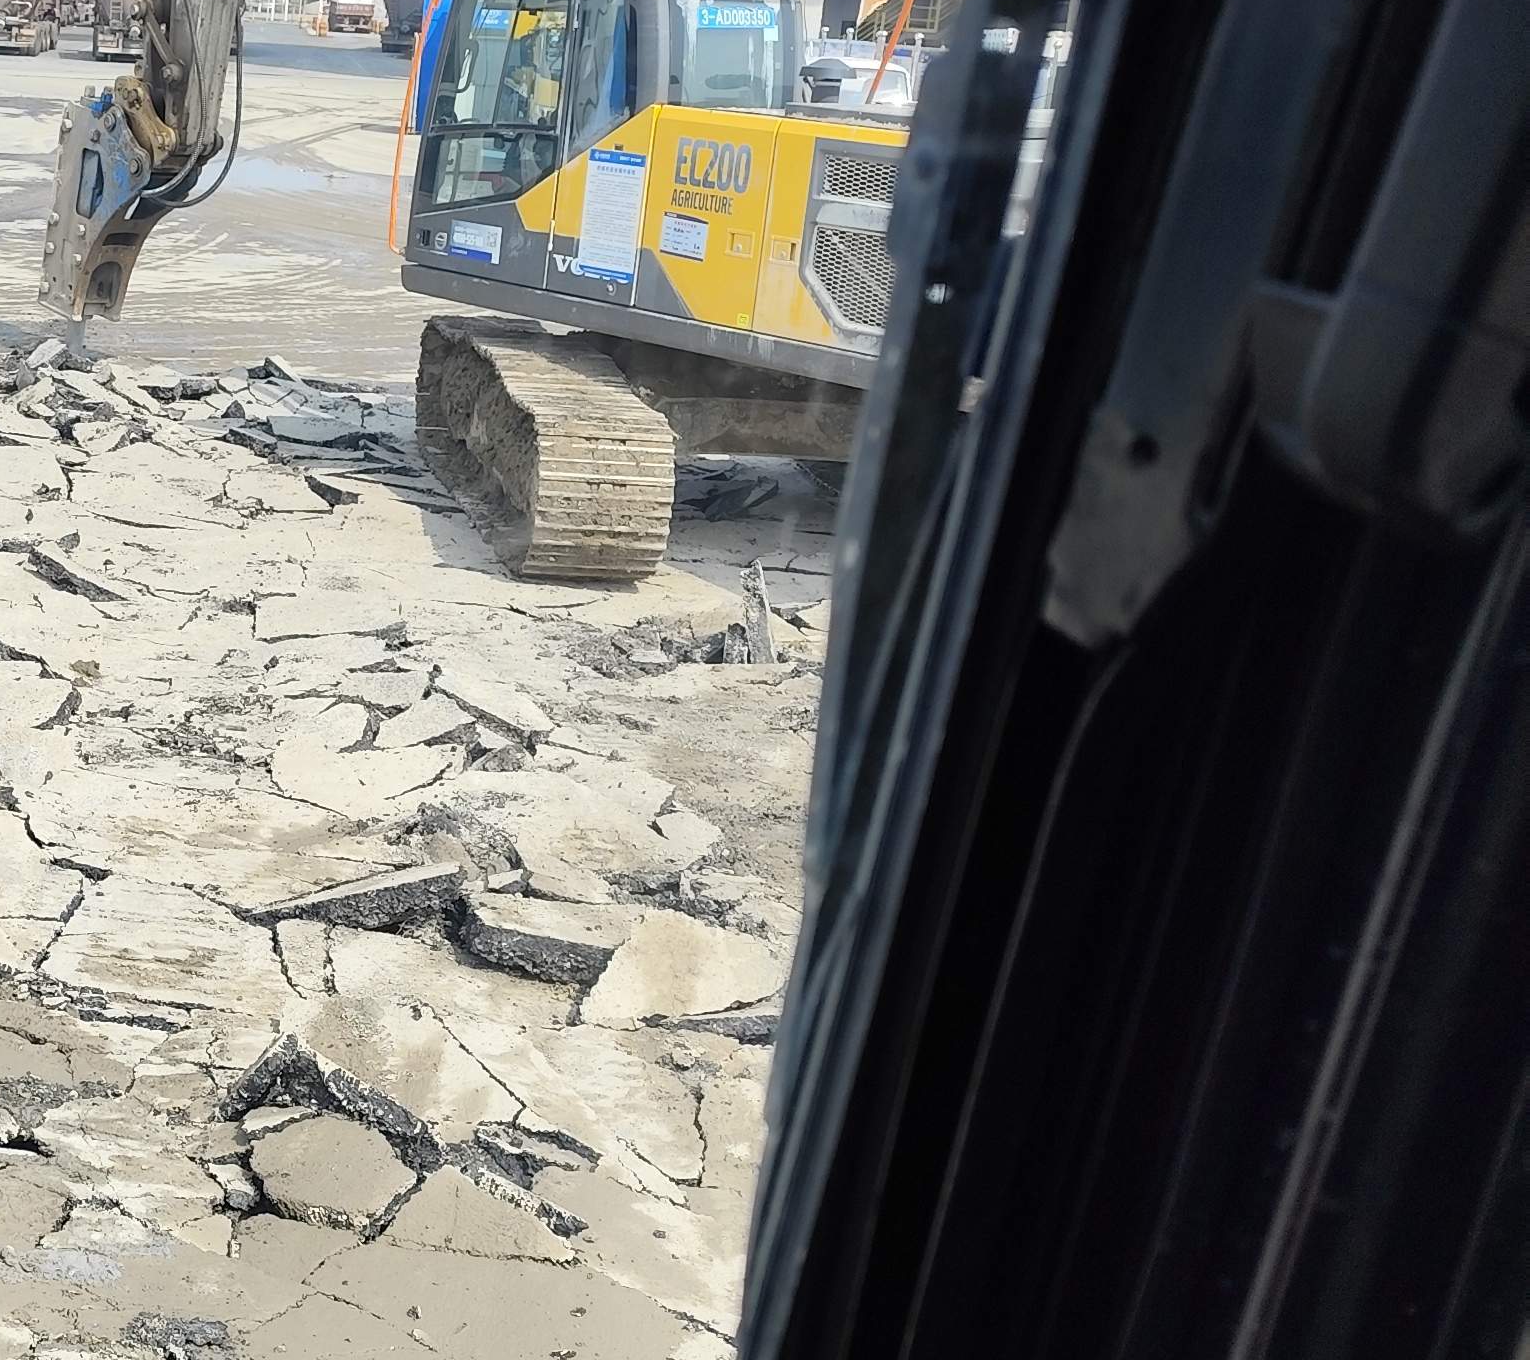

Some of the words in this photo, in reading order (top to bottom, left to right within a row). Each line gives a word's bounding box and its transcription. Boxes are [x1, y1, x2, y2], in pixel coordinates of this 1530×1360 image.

[701, 8, 771, 26] 3-AD003350
[675, 136, 752, 193] EC200
[670, 188, 734, 216] AGRICULTURE
